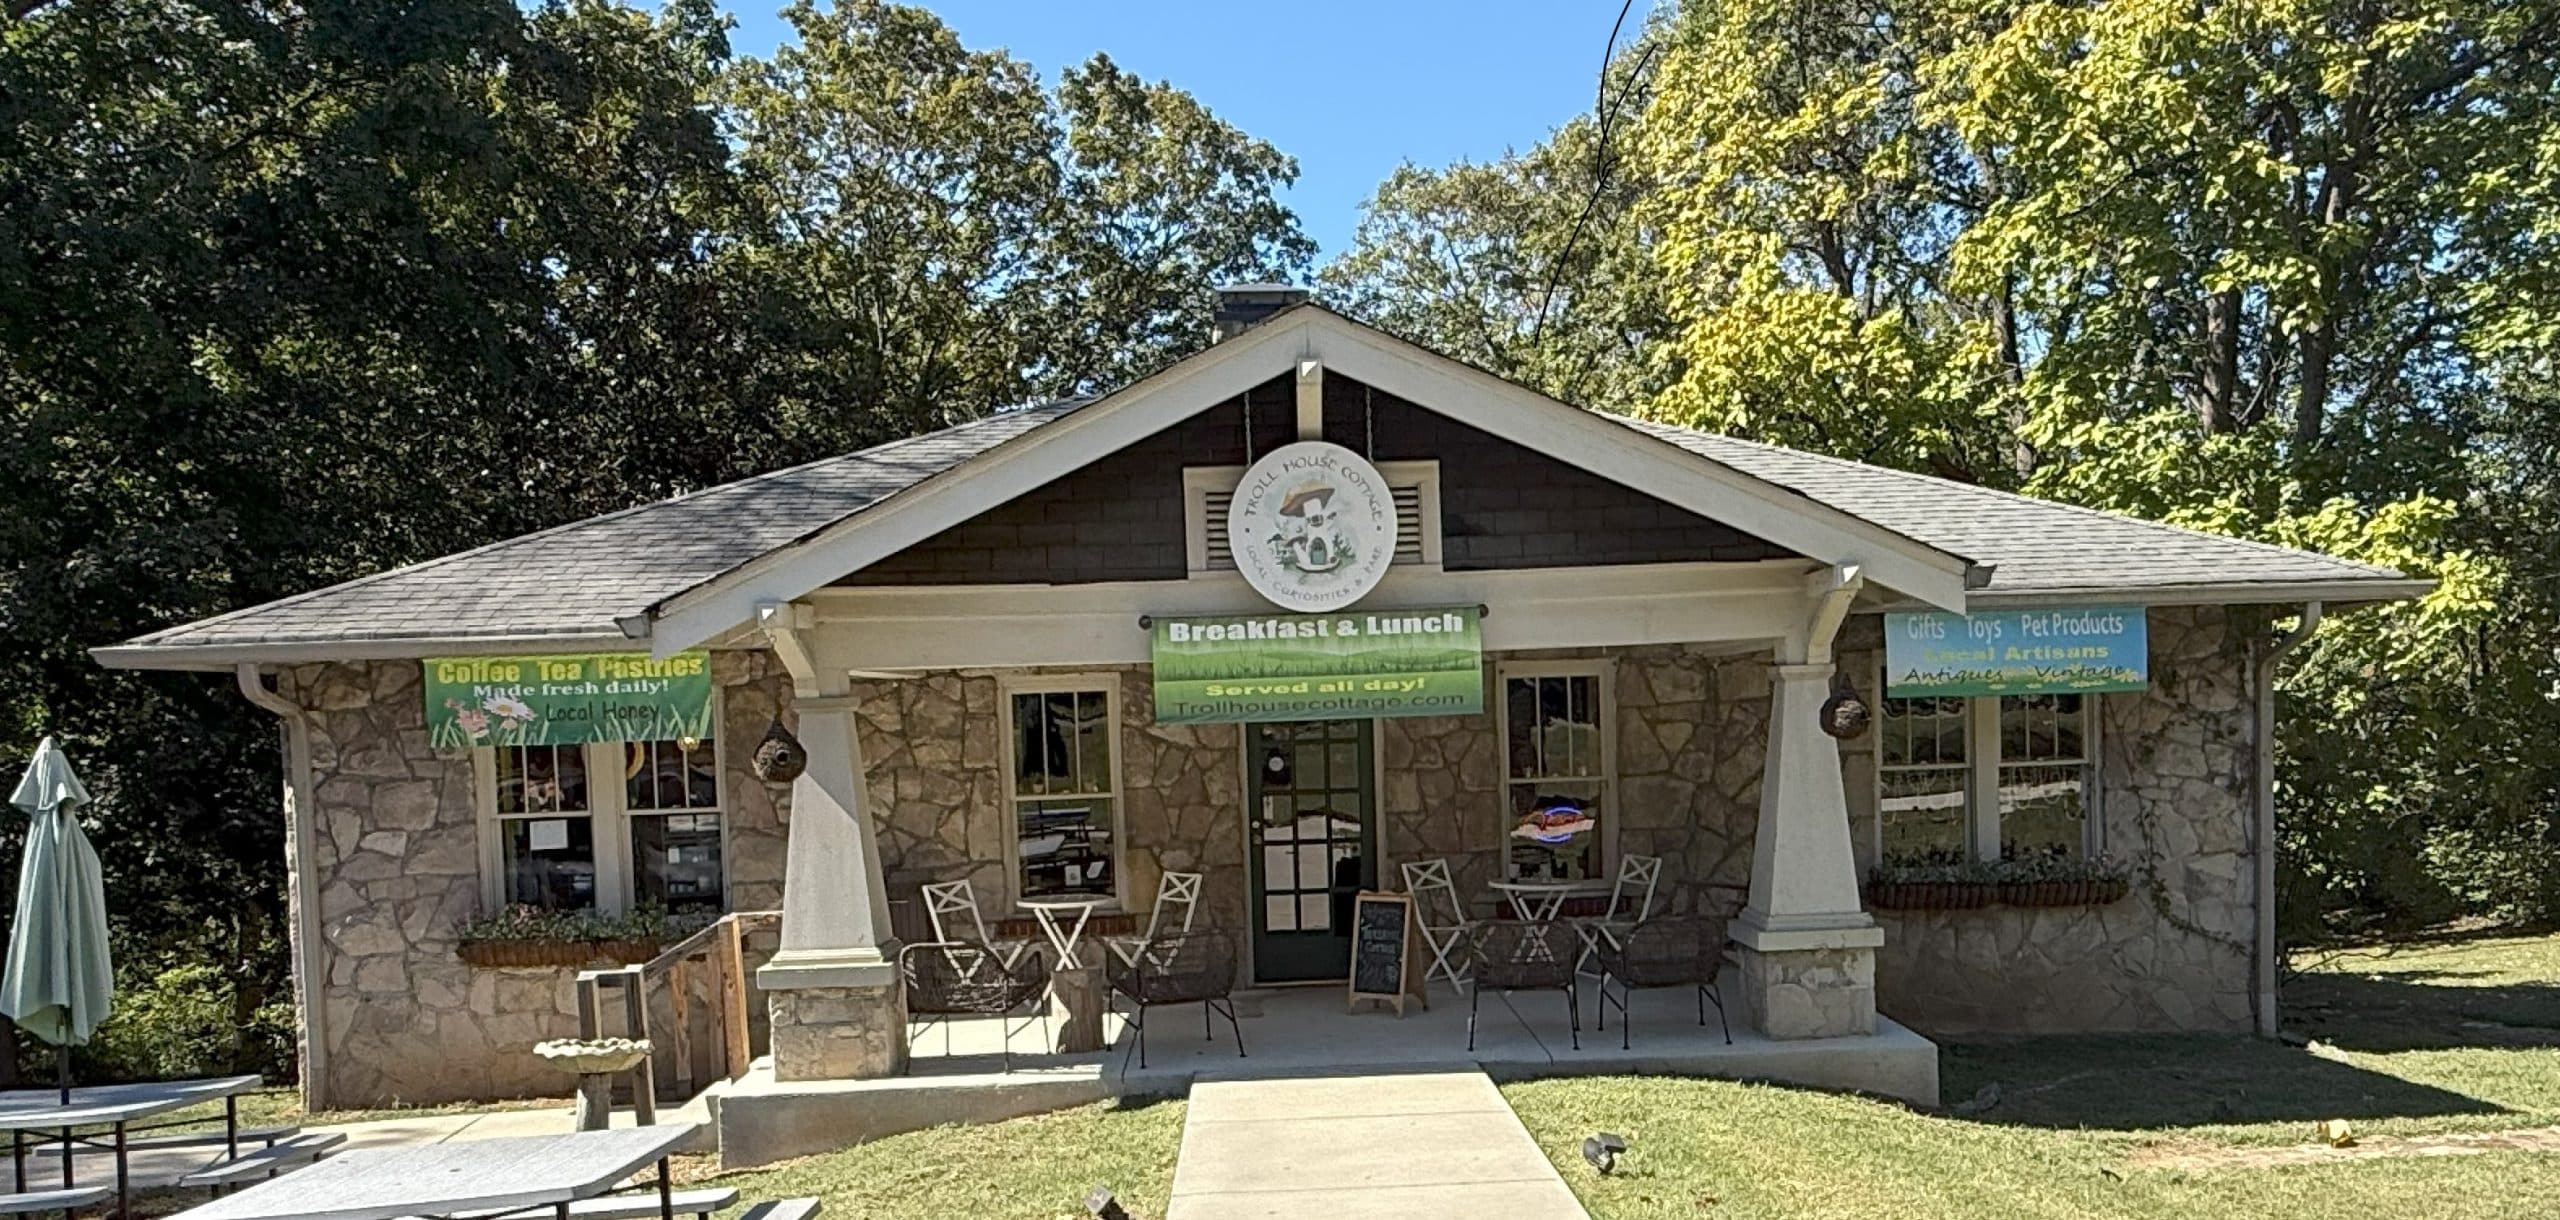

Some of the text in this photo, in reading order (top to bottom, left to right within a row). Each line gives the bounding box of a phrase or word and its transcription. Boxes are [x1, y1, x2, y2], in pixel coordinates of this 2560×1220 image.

[1244, 456, 1384, 522] TROLL HOUSE COTTAGE
[1169, 614, 1463, 642] Breakfast & Lunch
[1907, 611, 2123, 644] Gifts Toys Pet Products
[1924, 644, 2109, 662] Local Artisans
[437, 656, 703, 684] Coffee Tea Pastries
[1904, 664, 2123, 684] Antiques Vintage
[473, 679, 669, 698] Made fresh daily!
[1205, 677, 1425, 697] Served all day!
[546, 701, 660, 723] Local Honey
[1175, 694, 1464, 717] Trollhousecottage.com
